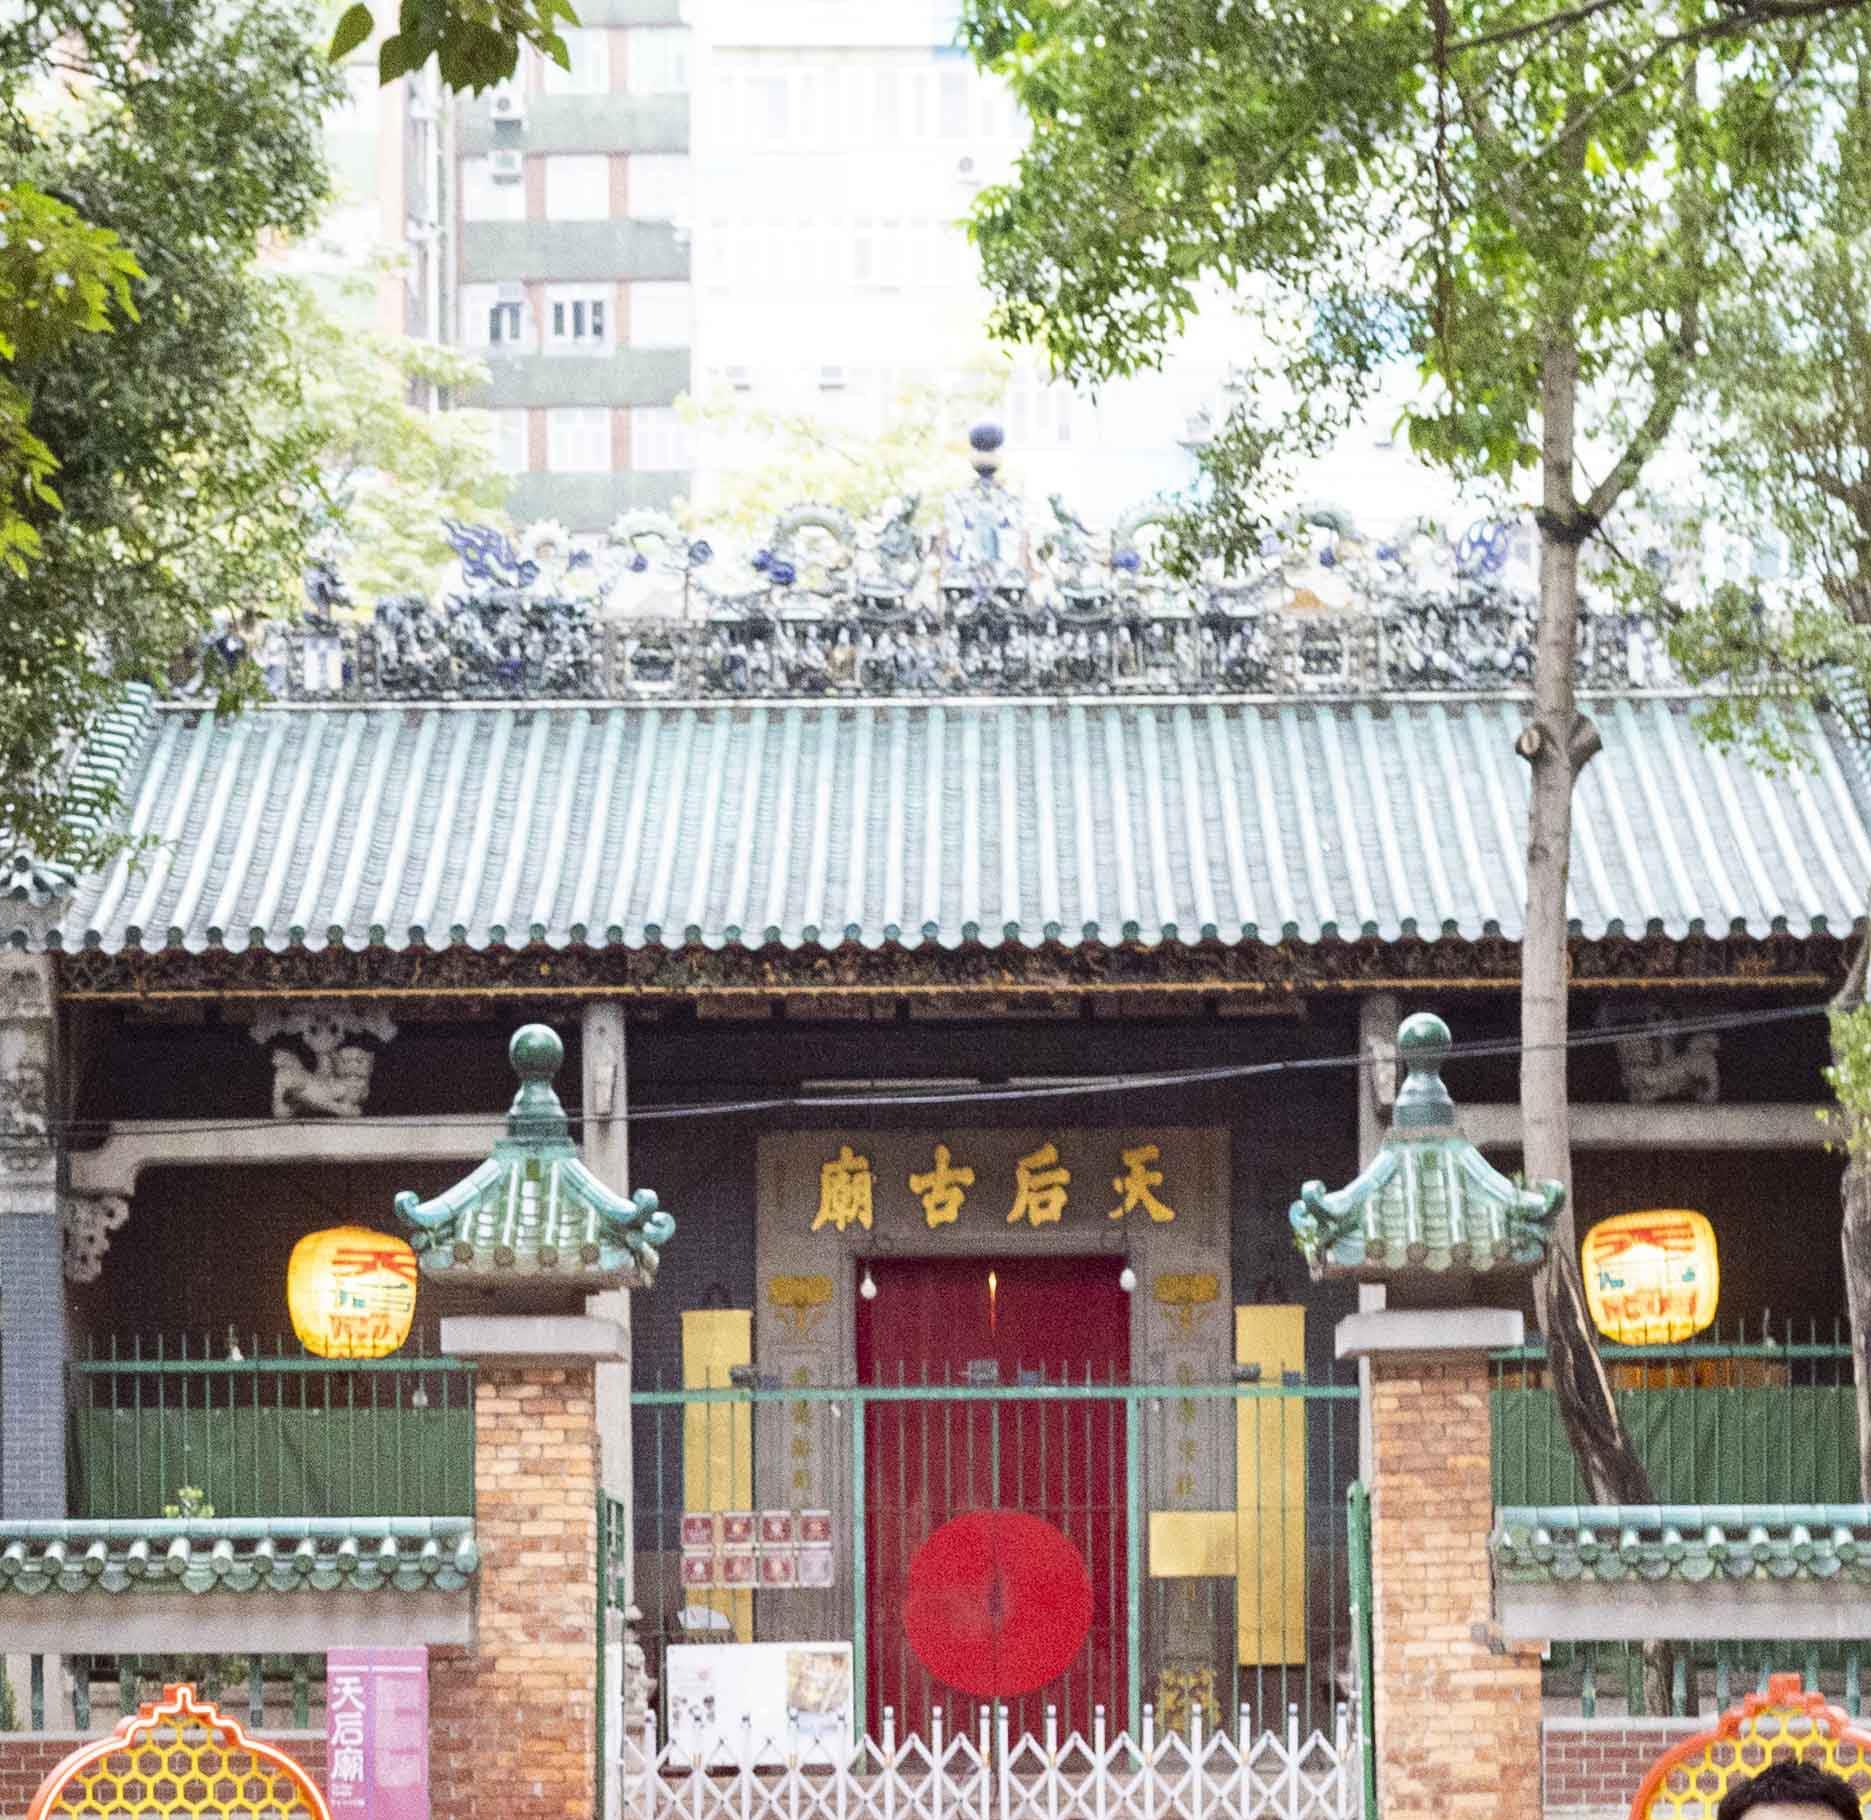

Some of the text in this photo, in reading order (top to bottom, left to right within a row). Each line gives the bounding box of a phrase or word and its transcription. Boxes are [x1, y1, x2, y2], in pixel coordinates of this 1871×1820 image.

[811, 1142, 1176, 1232] 天后古廟
[331, 1675, 366, 1782] 天后廟
